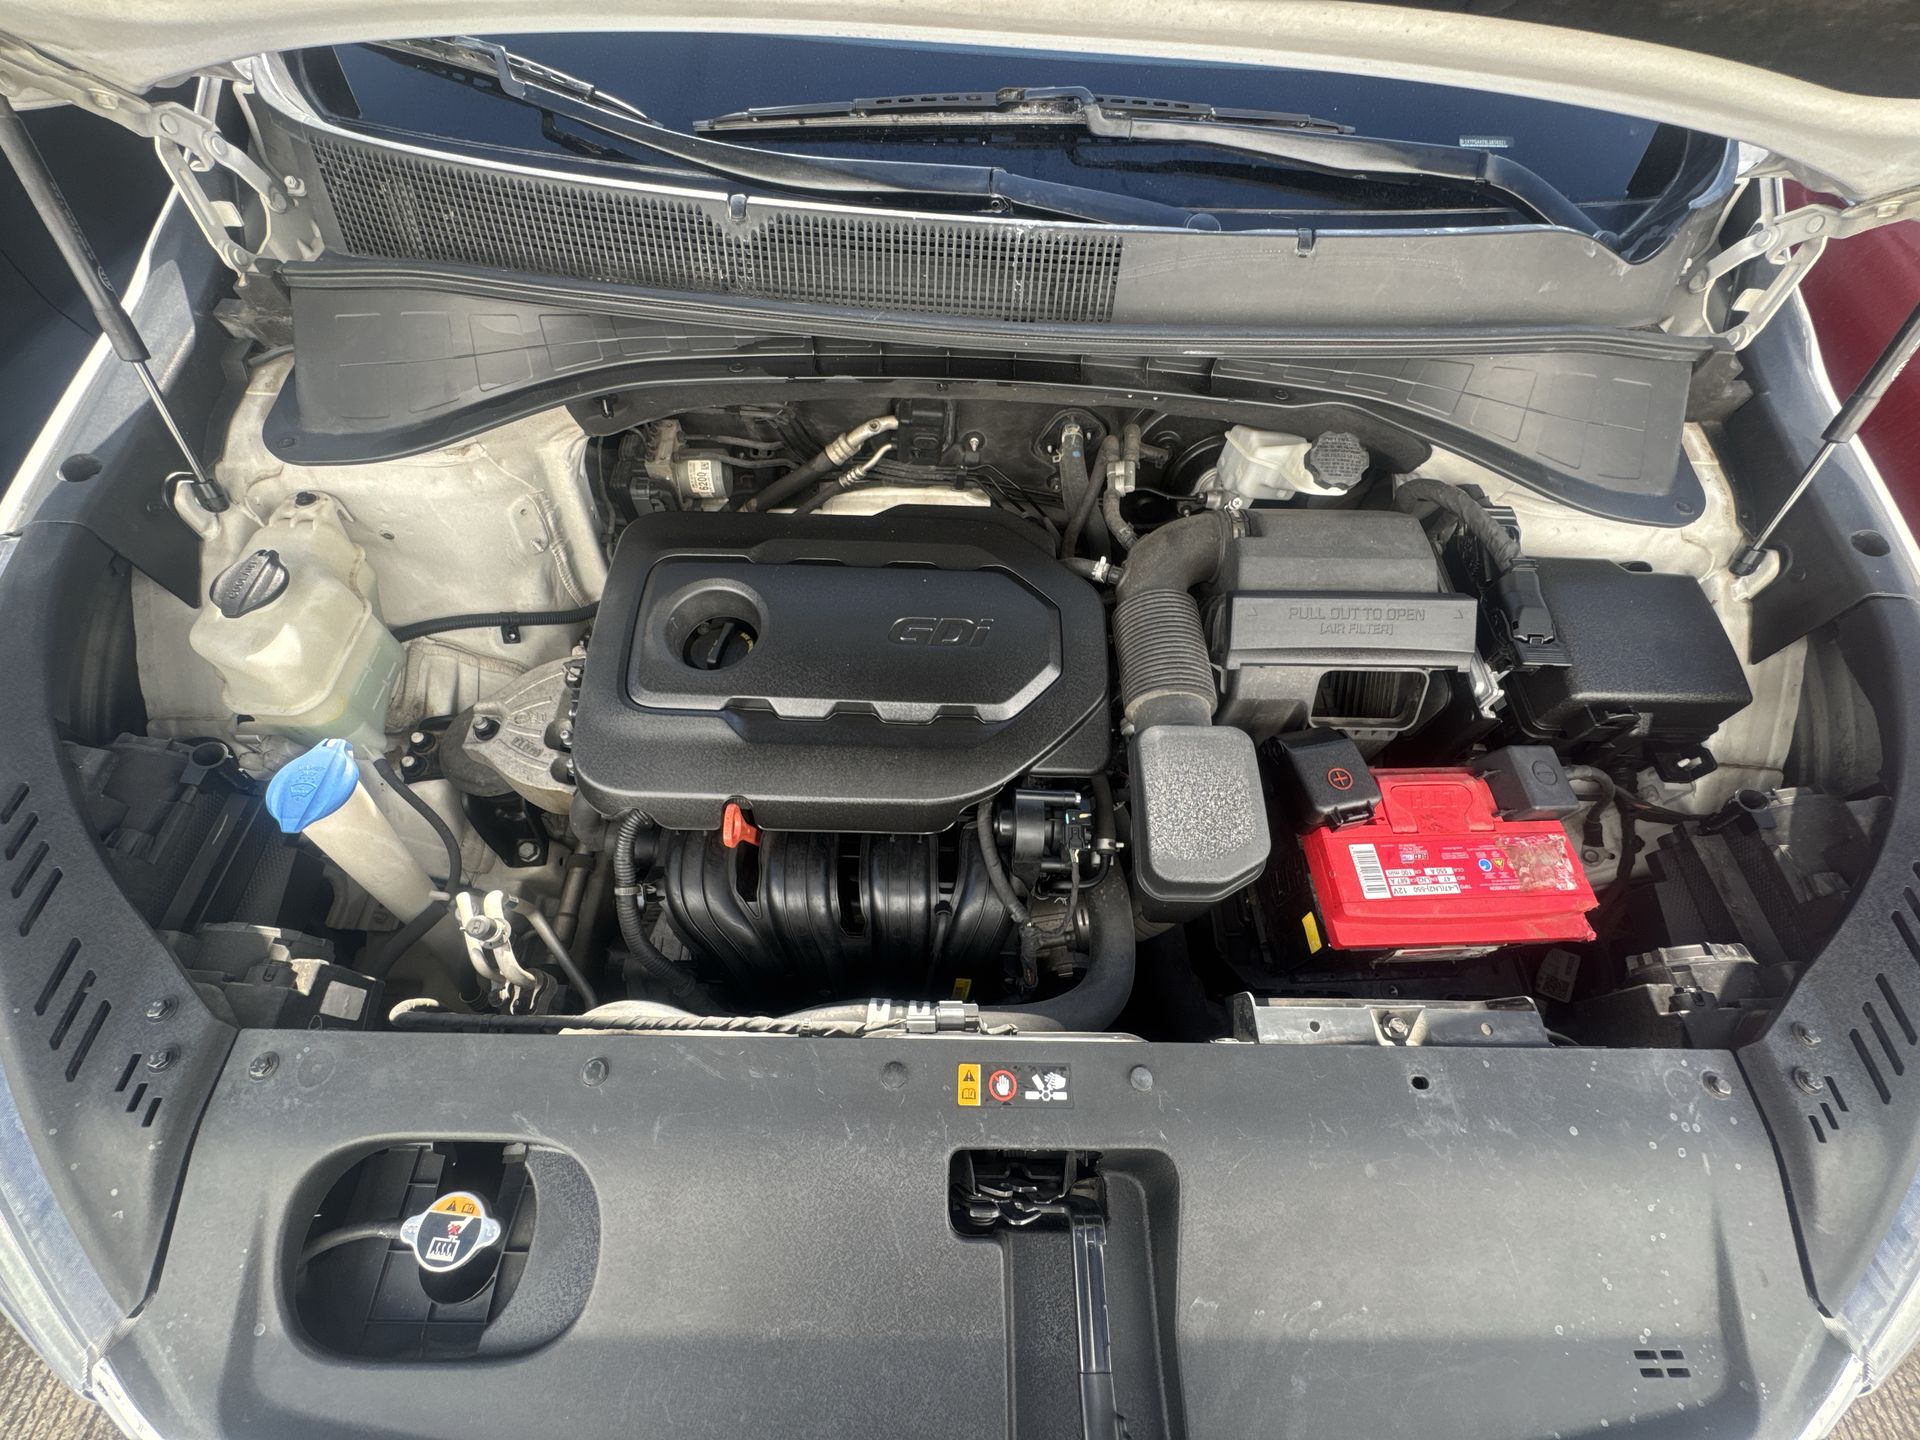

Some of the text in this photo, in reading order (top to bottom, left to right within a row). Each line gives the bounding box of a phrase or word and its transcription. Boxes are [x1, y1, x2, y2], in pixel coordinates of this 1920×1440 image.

[697, 472, 708, 490] 6200
[1289, 607, 1426, 621] PULL OUT TO OPEN
[888, 616, 994, 647] GDi
[1393, 887, 1408, 895] 12V
